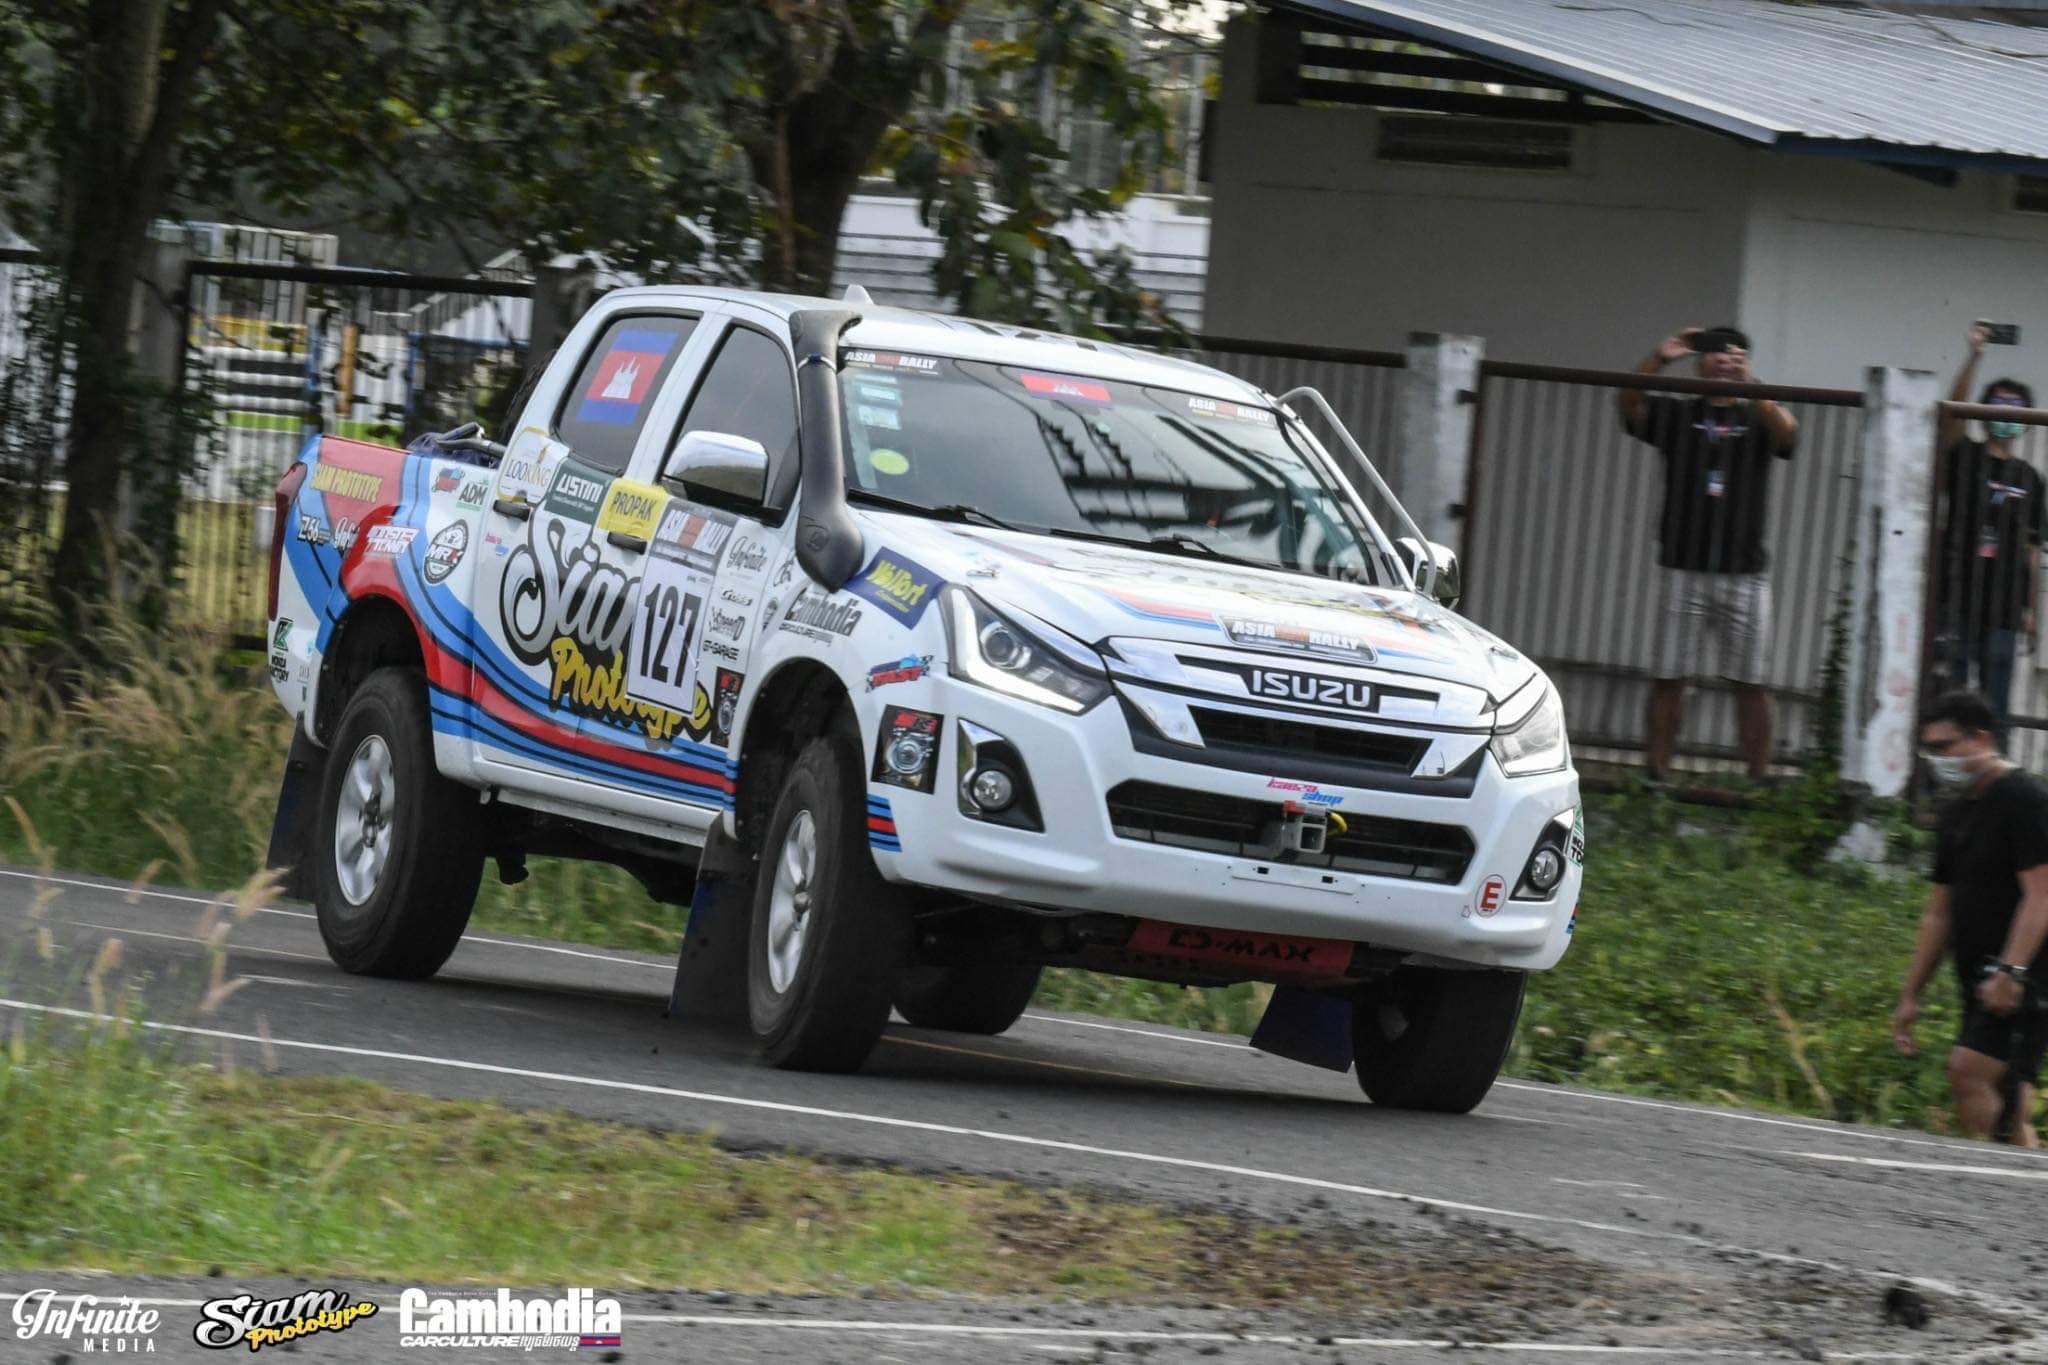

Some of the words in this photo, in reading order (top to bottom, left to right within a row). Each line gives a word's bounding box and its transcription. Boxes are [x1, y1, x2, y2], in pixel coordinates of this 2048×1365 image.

[845, 351, 876, 363] ASIA
[898, 356, 938, 370] RALLY
[505, 459, 552, 487] LOOKING
[459, 482, 488, 506] ADM
[612, 490, 657, 521] PROPAK
[640, 583, 703, 688] 127
[1231, 620, 1276, 638] ASIA
[1308, 631, 1361, 650] RALLY
[1252, 669, 1371, 708] ISUZU
[1480, 882, 1502, 909] E
[1168, 927, 1316, 962] D-MAX
